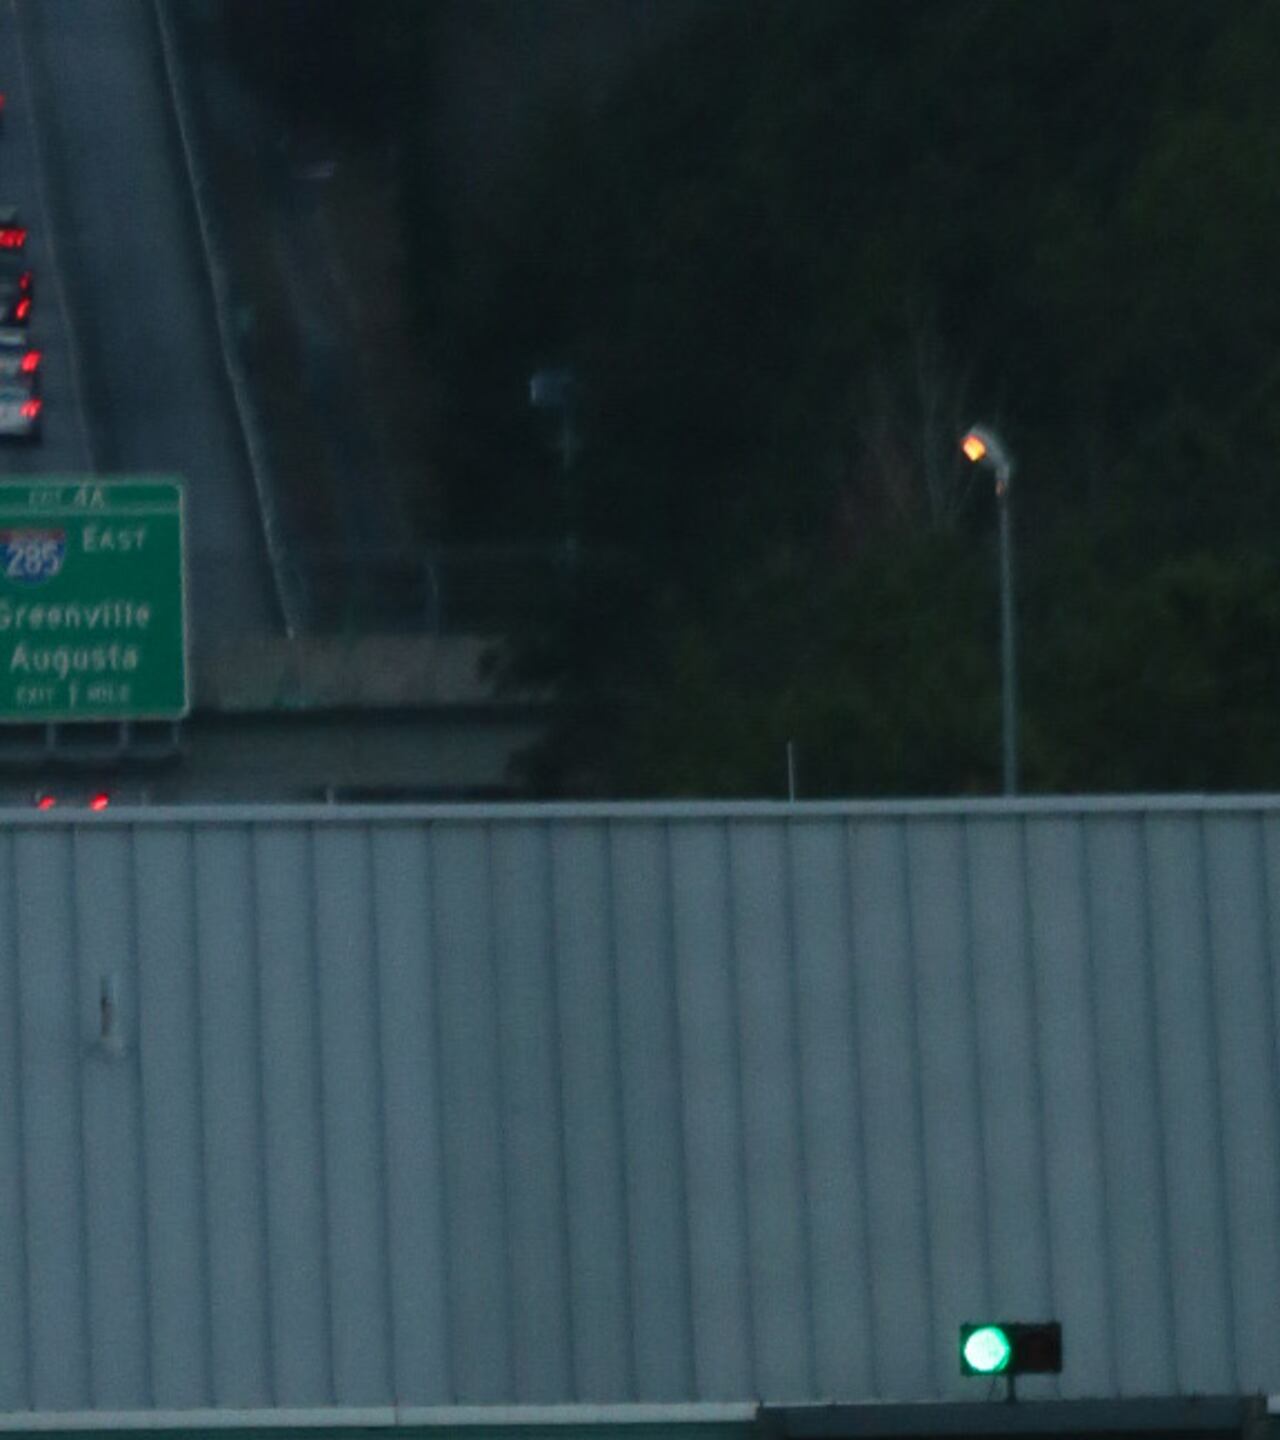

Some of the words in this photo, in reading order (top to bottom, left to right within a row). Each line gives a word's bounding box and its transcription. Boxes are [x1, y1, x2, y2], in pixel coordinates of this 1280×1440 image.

[82, 525, 146, 552] EAST
[7, 541, 61, 577] 285
[9, 643, 139, 680] Augusta
[16, 684, 53, 705] EXIT
